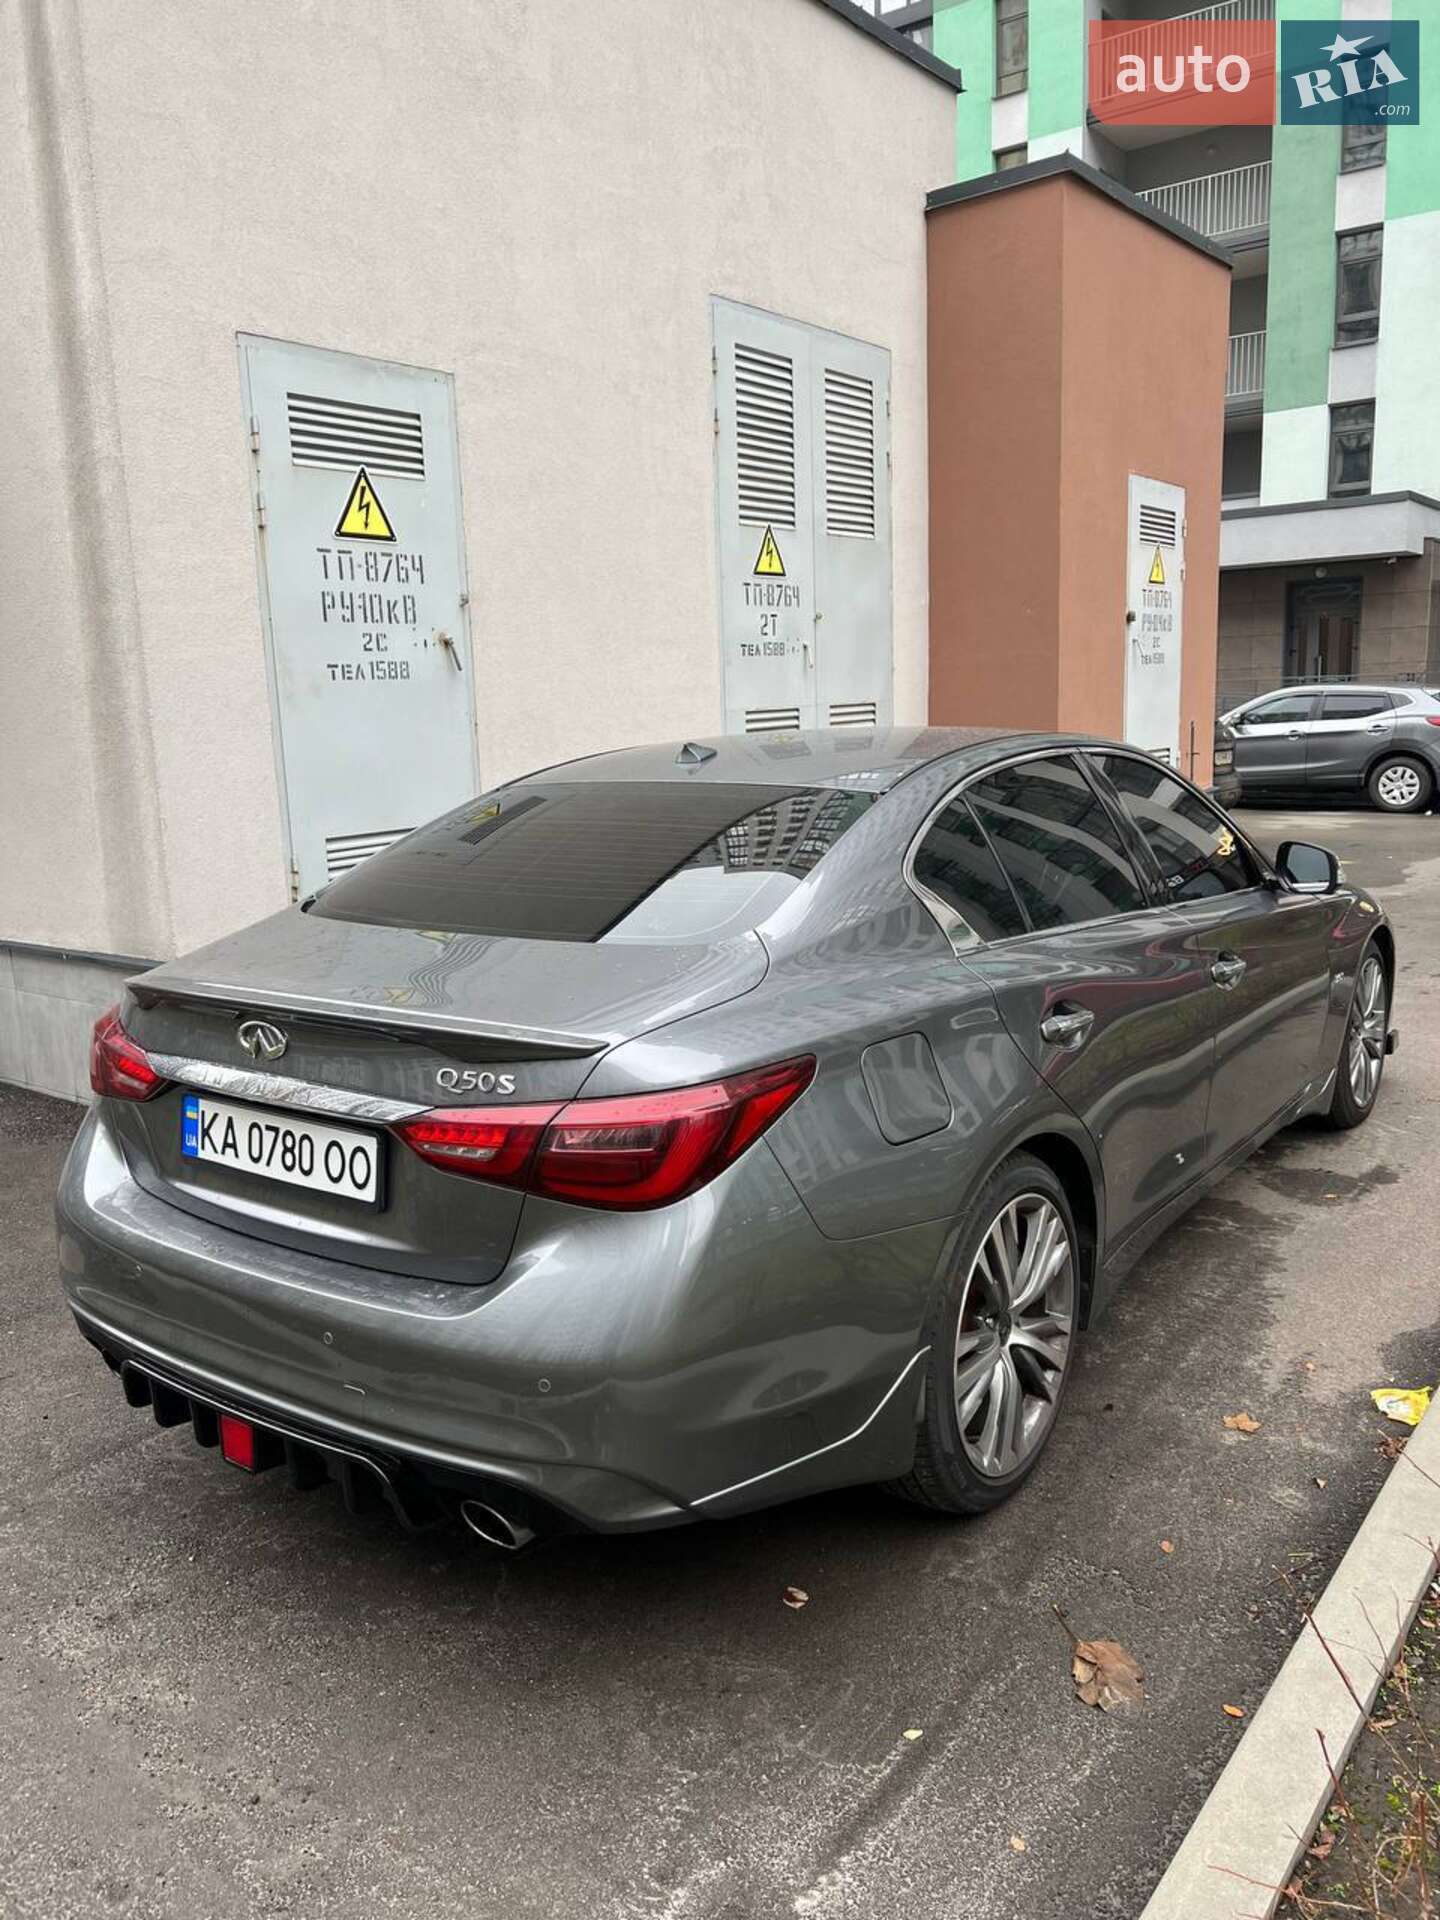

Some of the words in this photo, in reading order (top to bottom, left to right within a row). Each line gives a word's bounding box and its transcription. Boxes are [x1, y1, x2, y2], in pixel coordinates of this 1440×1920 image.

[435, 1067, 517, 1096] Q50S
[200, 1109, 240, 1159] KA
[248, 1121, 315, 1178] 0780
